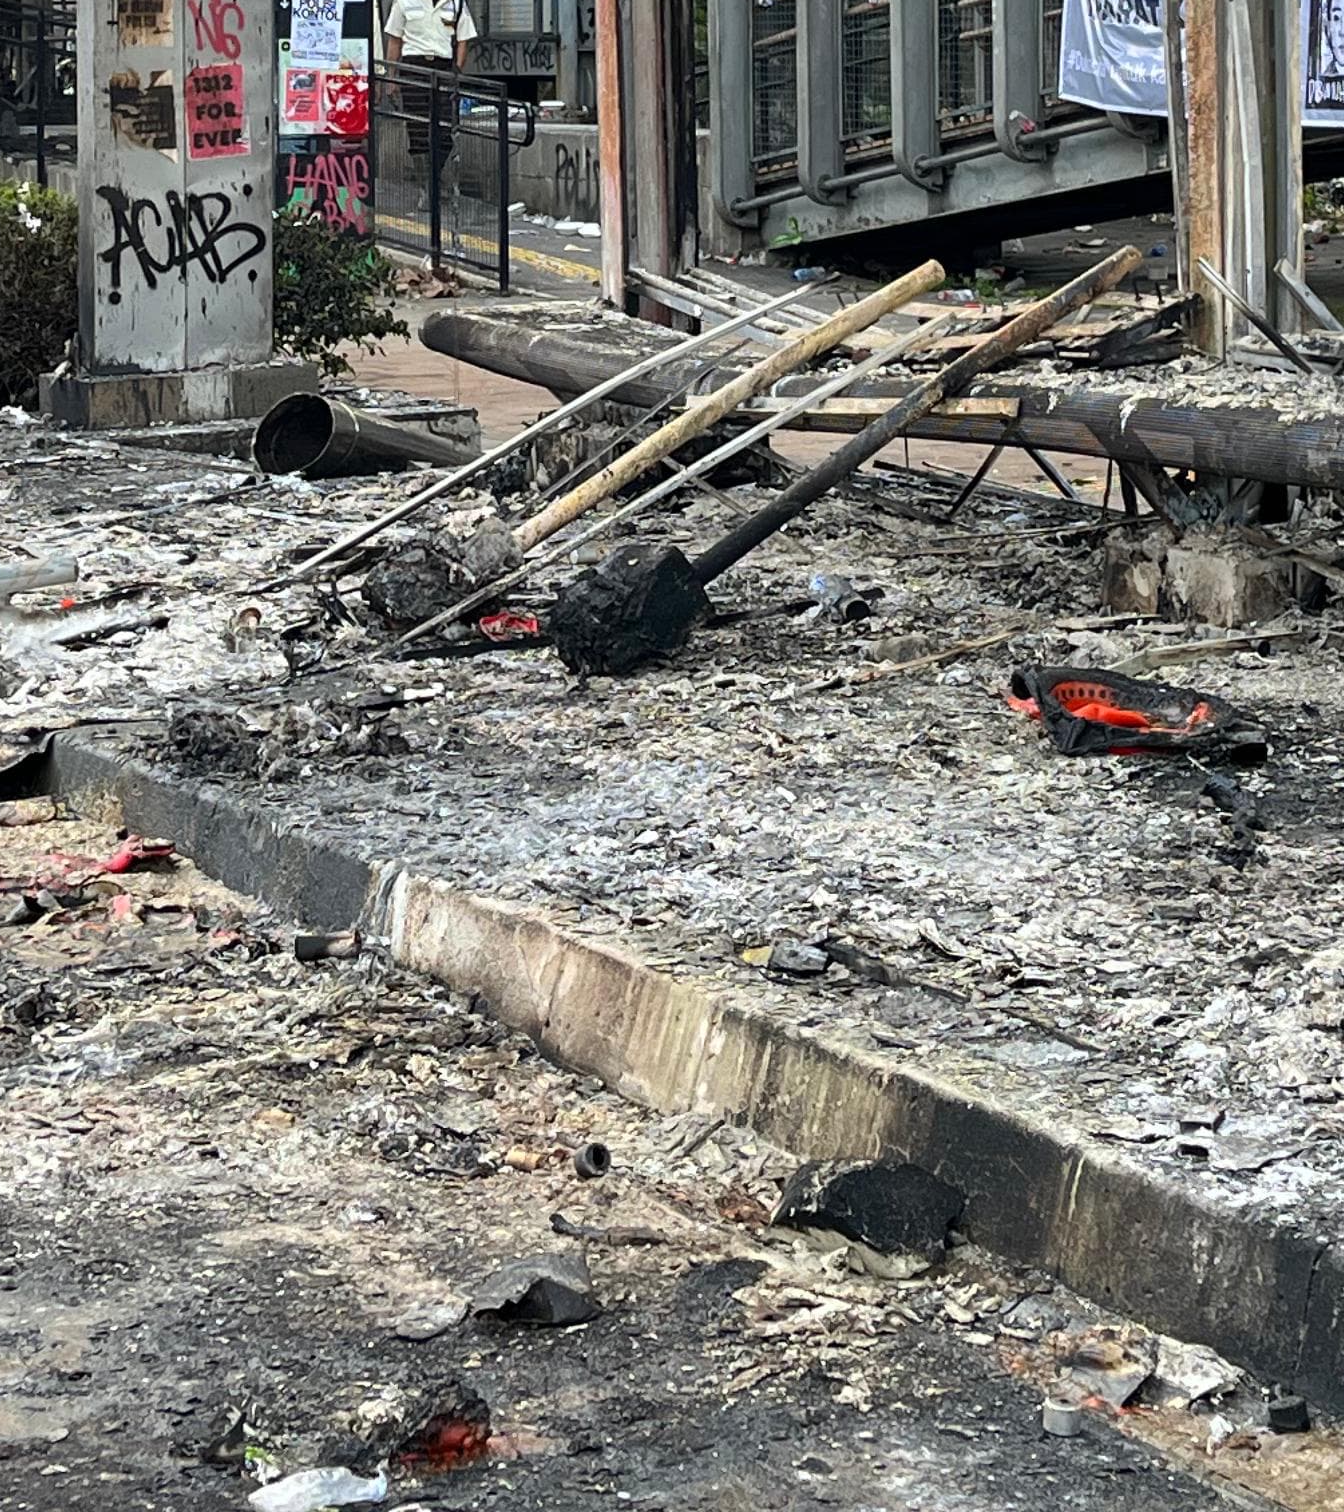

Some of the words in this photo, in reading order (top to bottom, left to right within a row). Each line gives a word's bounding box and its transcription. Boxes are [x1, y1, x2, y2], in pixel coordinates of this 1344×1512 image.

[197, 102, 242, 120] FOR
[286, 153, 369, 201] HANG
[96, 185, 266, 290] ACAB
